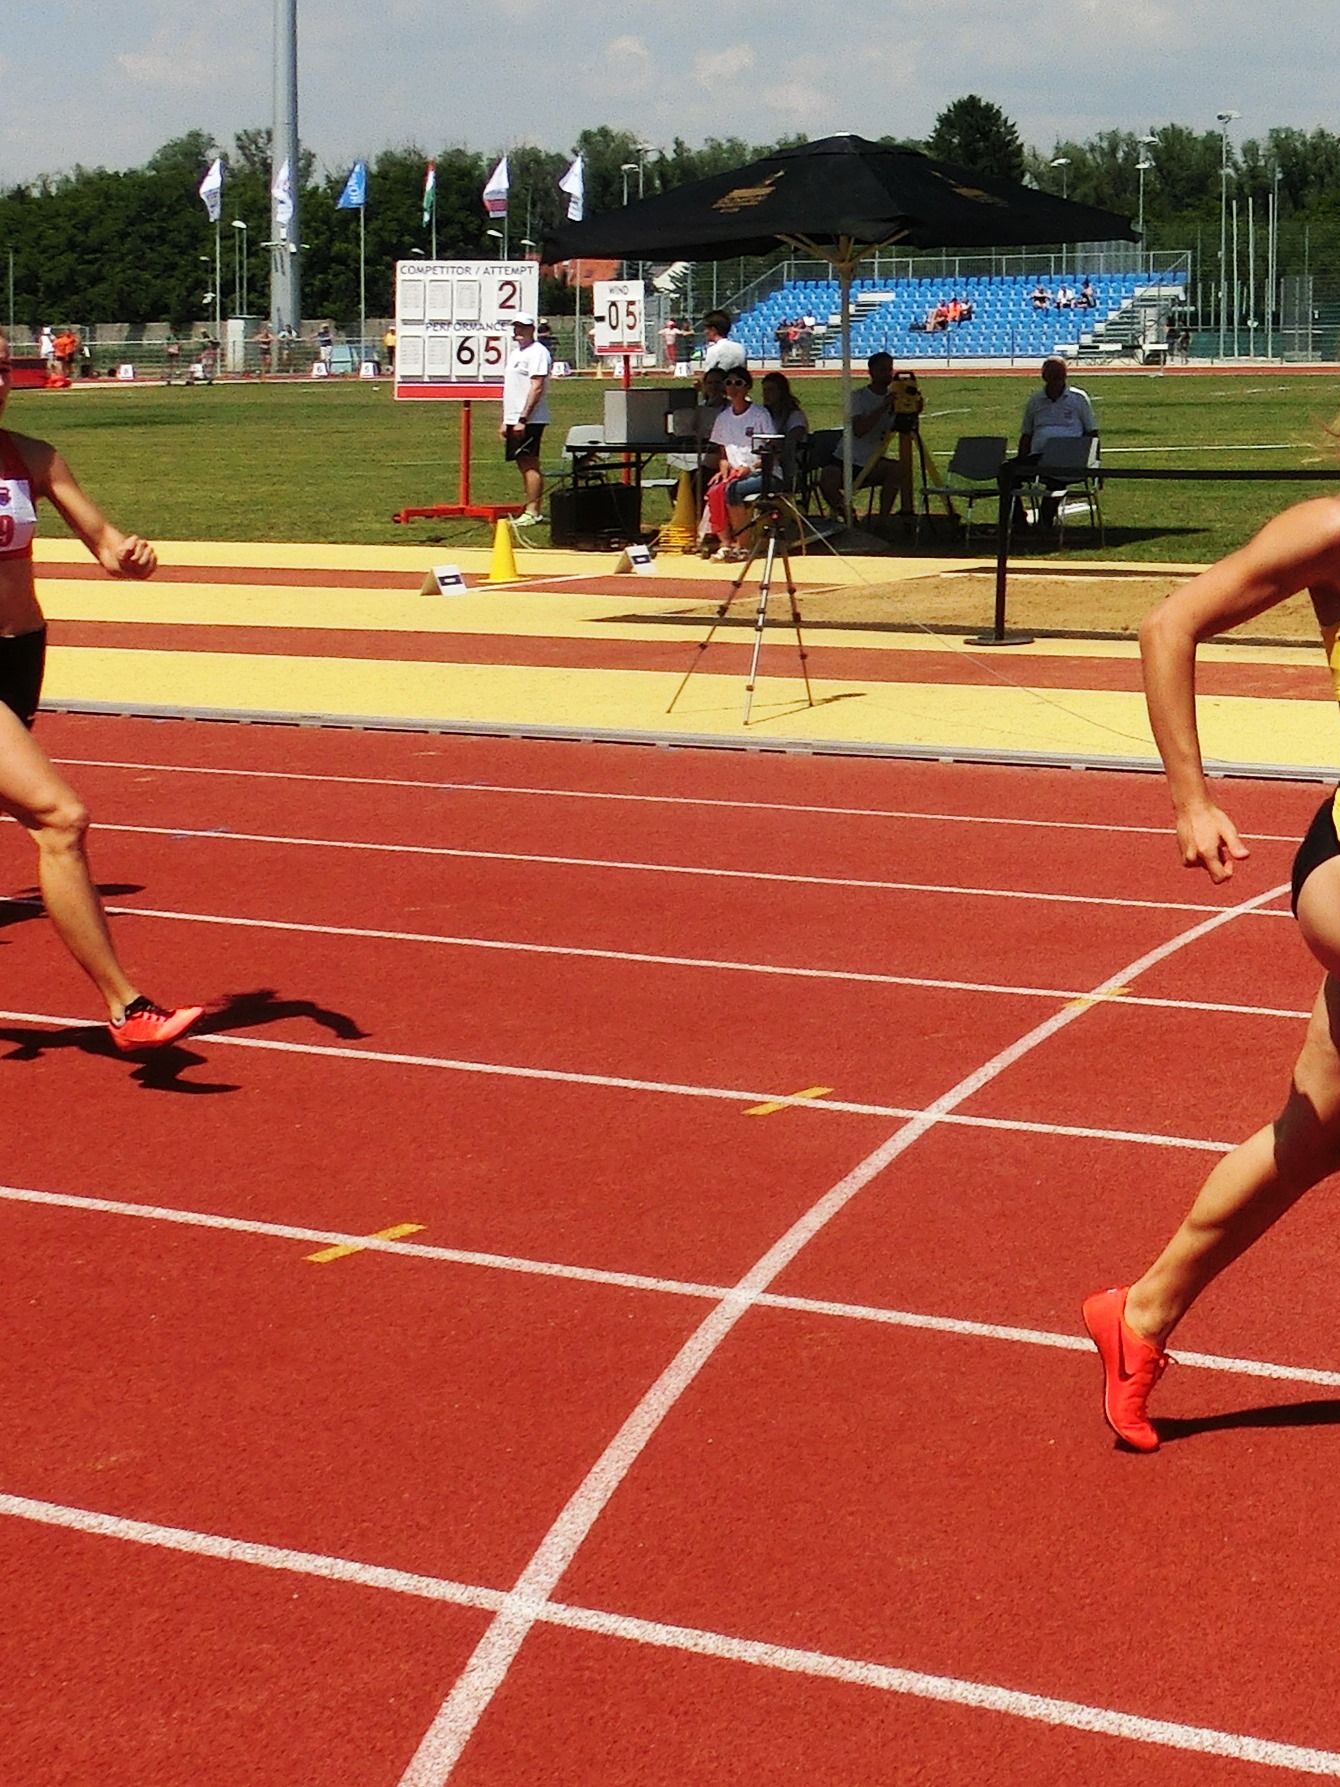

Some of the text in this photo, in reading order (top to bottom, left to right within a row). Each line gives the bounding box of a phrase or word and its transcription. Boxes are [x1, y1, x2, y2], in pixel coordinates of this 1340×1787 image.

[400, 265, 472, 276] COMPETITOR
[483, 265, 534, 276] ATTEMPT
[498, 280, 517, 310] 2
[425, 322, 508, 332] PERFORMANCE
